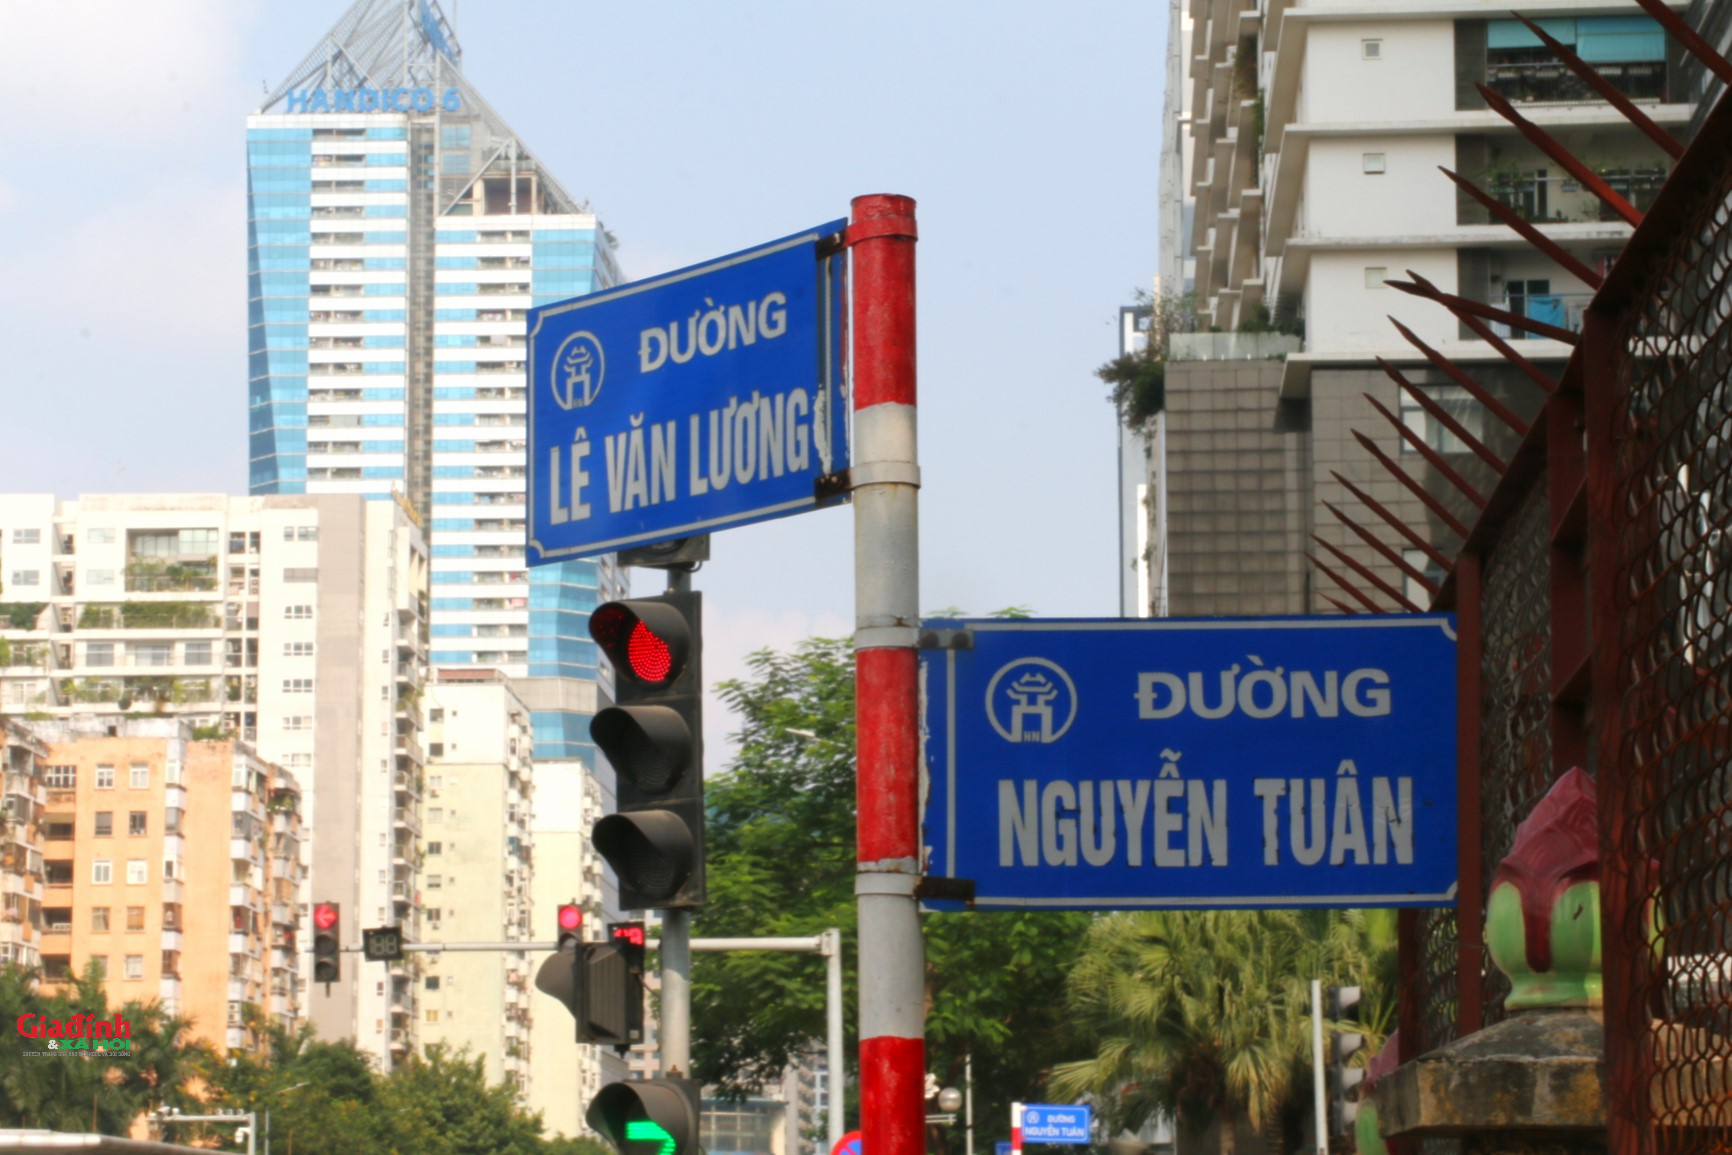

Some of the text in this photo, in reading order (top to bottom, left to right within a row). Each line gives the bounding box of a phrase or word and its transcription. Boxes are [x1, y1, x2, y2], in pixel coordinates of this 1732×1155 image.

[287, 86, 461, 113] HANDICO 6
[638, 291, 787, 373] ĐƯỜNG
[550, 387, 809, 525] LÊ VĂN LƯƠNG
[1134, 654, 1392, 720] ĐƯỜNG
[998, 748, 1414, 868] NGUYỄN TUÂN
